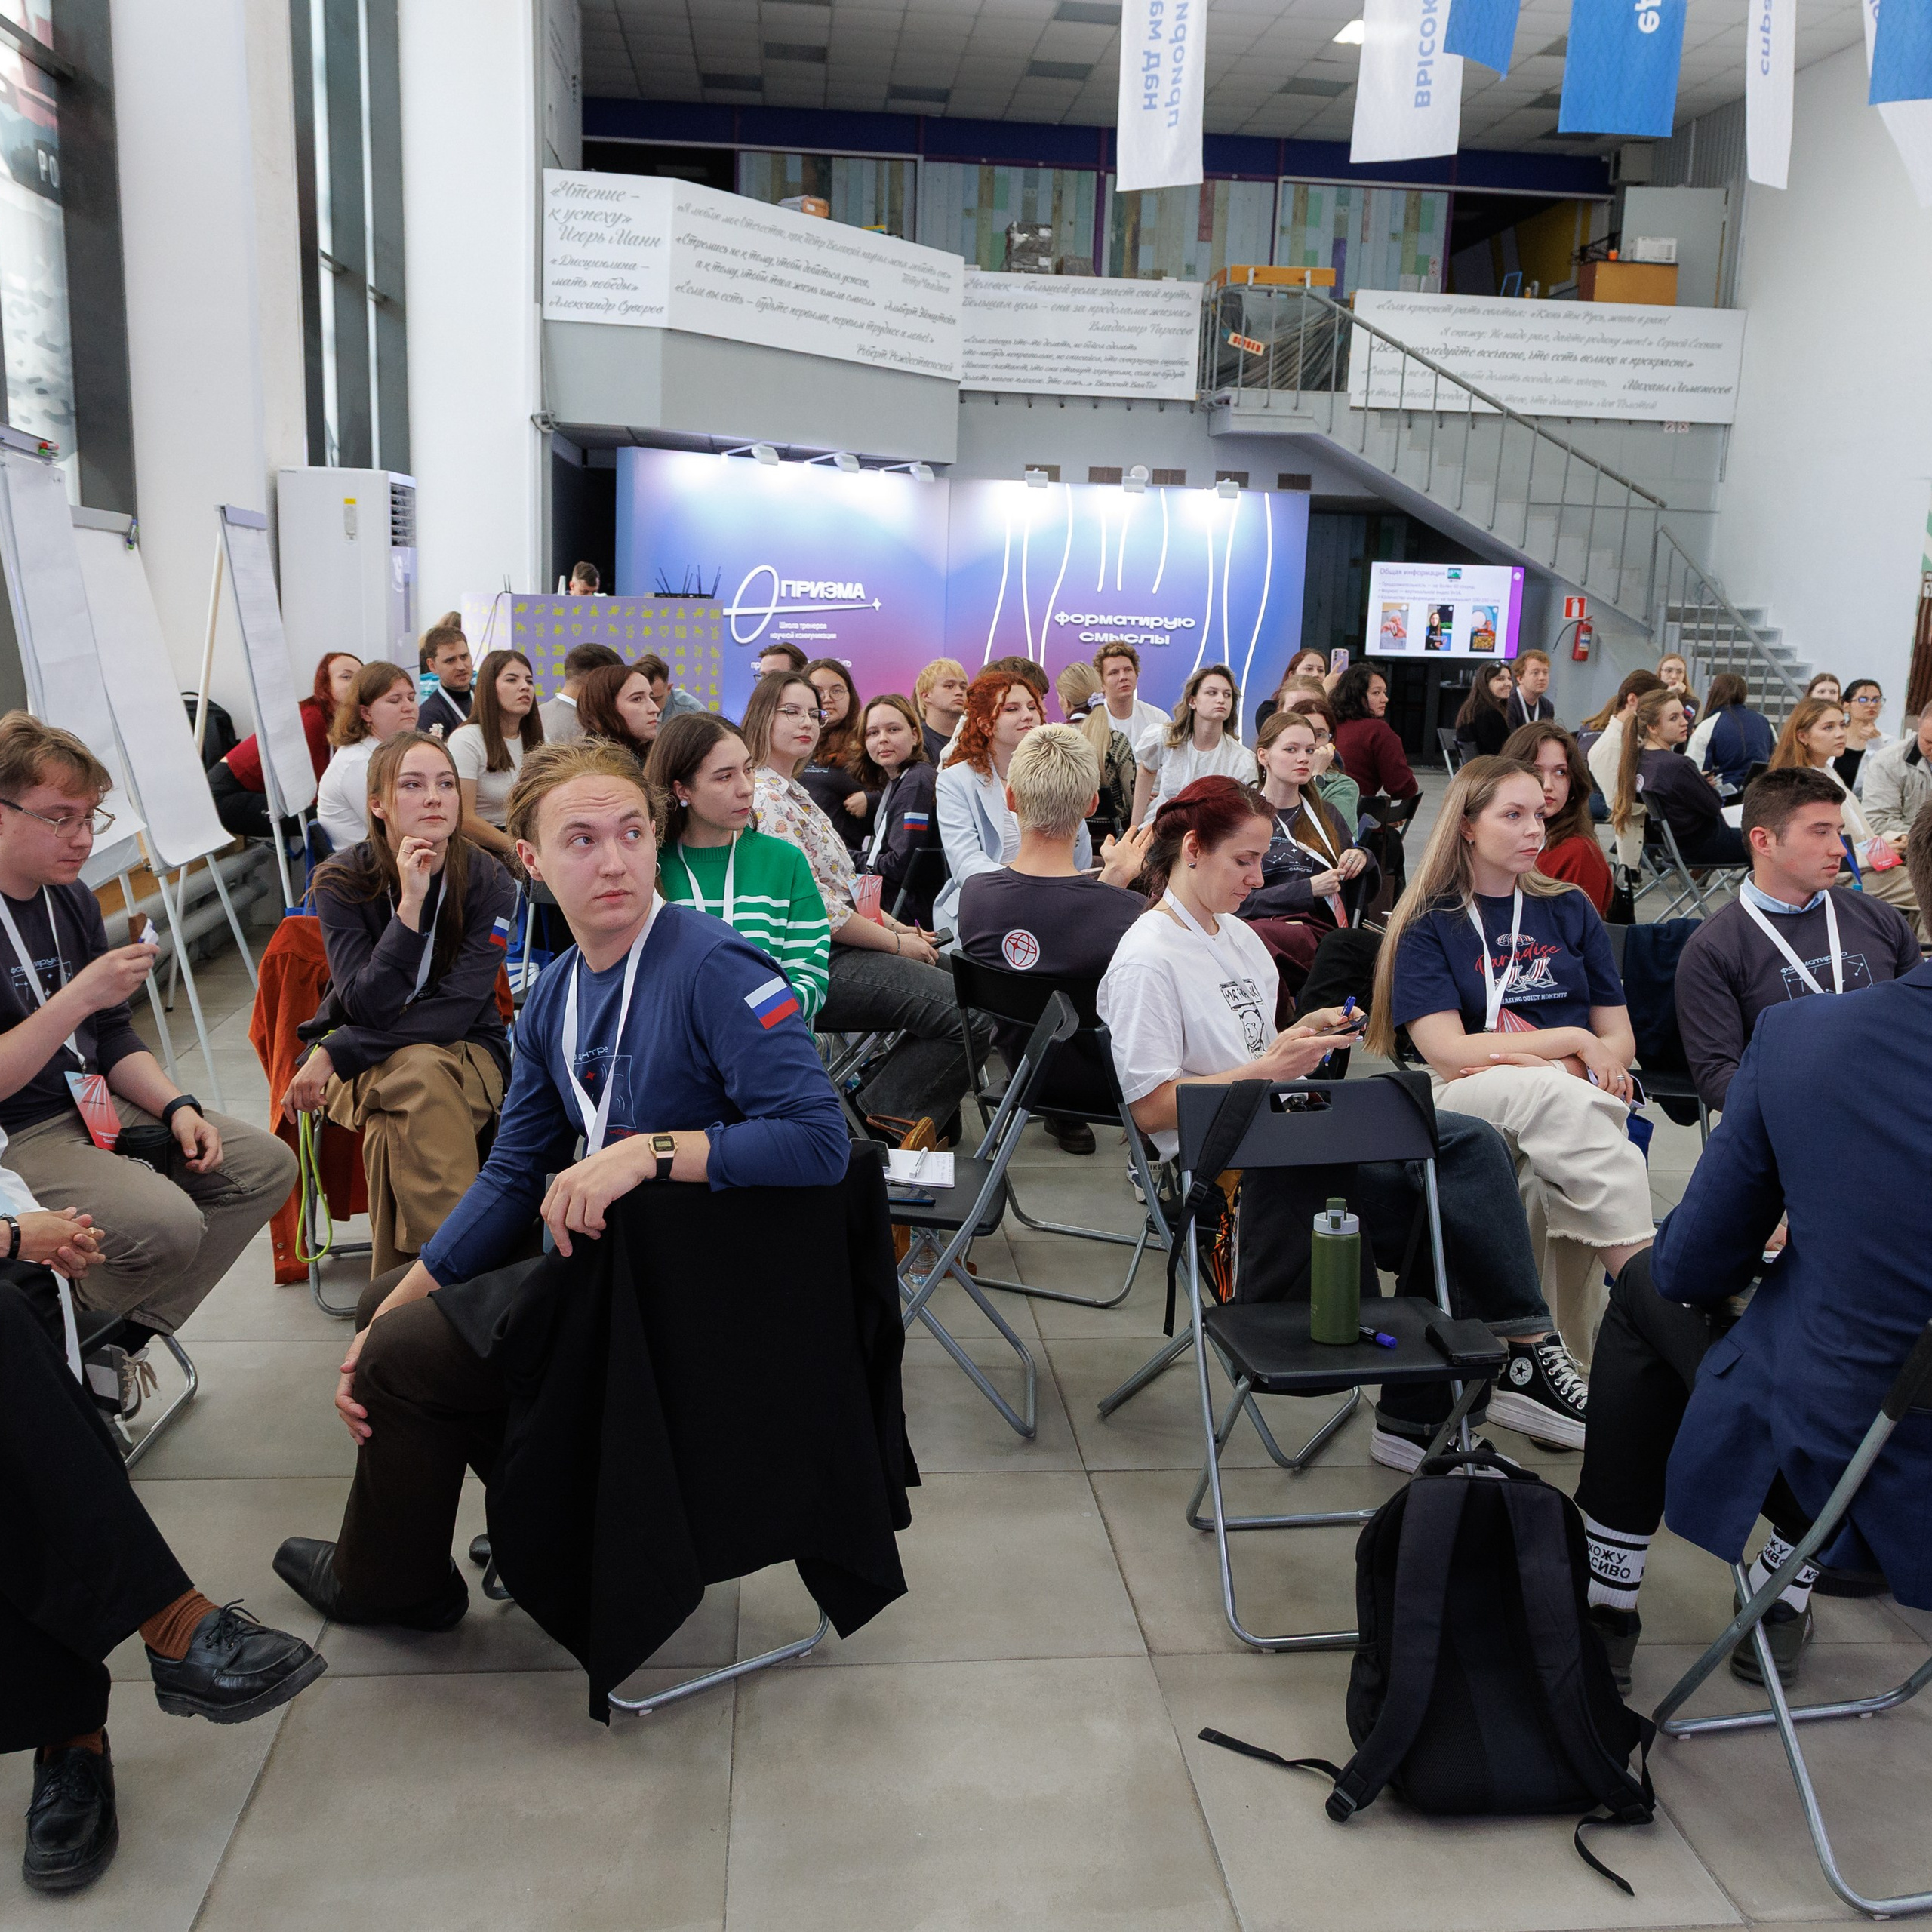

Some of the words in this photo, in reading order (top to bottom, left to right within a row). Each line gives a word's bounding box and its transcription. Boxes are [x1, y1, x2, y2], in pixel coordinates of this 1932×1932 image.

[550, 180, 626, 202] «Чтение
[548, 208, 562, 222] к
[559, 208, 632, 228] успеху»
[558, 225, 605, 248] Игорь
[608, 228, 661, 248] Манн
[549, 254, 638, 271] «Дисциплина
[675, 232, 728, 251] «Стремись
[728, 247, 739, 257] не
[740, 250, 748, 260] к
[748, 249, 775, 269] тому,
[775, 256, 802, 273] чтобы
[839, 275, 870, 289] успеха,
[694, 259, 703, 269] а
[703, 261, 711, 272] к
[711, 261, 740, 280] тому,
[739, 268, 768, 284] чтобы
[551, 276, 587, 288] мать
[590, 277, 639, 291] победы»
[1135, 288, 1161, 298] свой
[549, 296, 616, 313] Александр
[617, 300, 665, 316] Суворов
[705, 290, 721, 300] вы
[720, 292, 744, 305] есть
[755, 296, 790, 314] будьте
[1088, 319, 1149, 335] Владимир
[1149, 322, 1195, 337] Тарасов
[1622, 378, 1672, 392] Михаил
[1671, 380, 1734, 395] Ломоносов
[780, 579, 866, 600] ПРИЗМА
[1054, 611, 1196, 630] форматирую
[1078, 631, 1170, 645] смыслы
[1500, 995, 1523, 1004] ASING
[1523, 994, 1540, 1002] QUIET
[1540, 992, 1568, 1001] MOMENTS
